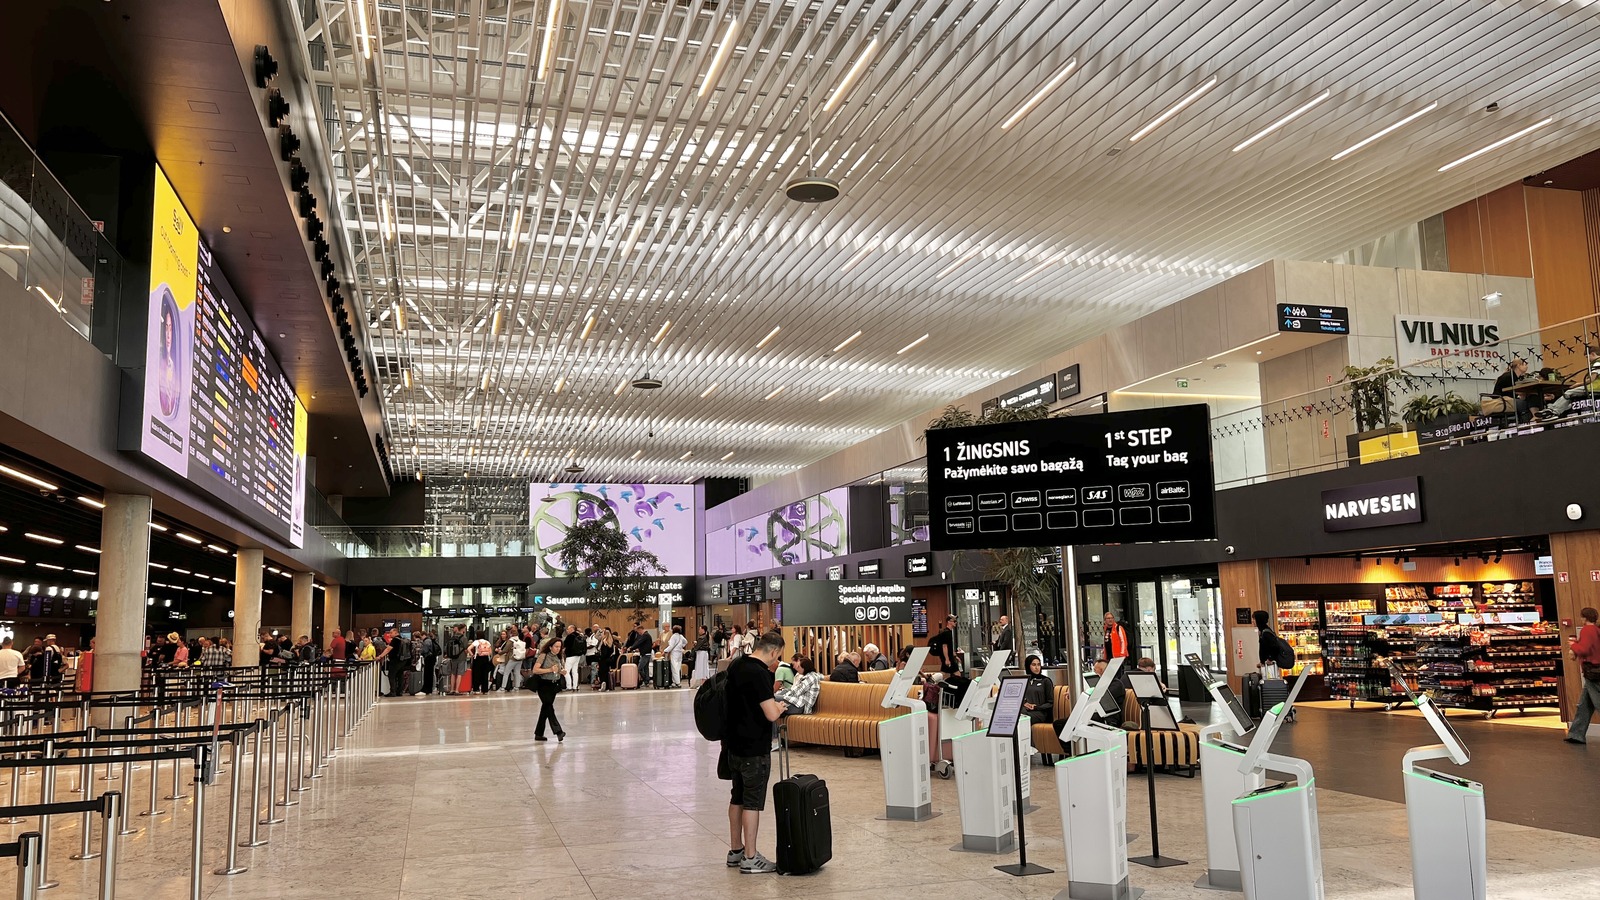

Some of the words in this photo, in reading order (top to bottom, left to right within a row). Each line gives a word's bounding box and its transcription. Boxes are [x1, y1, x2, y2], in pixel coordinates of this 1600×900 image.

[1401, 320, 1500, 347] VILNIUS
[1431, 348, 1450, 356] BAR
[1464, 350, 1499, 358] BISTRO
[1104, 430, 1125, 448] 1st
[1127, 427, 1173, 447] STEP
[944, 446, 951, 462] 1
[957, 440, 1030, 461] ŽINGSNIS
[1105, 454, 1129, 468] Tag
[1131, 453, 1161, 468] your
[1163, 450, 1189, 464] bag
[944, 463, 1008, 480] Pažymėkite
[1010, 463, 1038, 474] savo
[1040, 457, 1084, 473] bagažą
[1086, 489, 1109, 500] SAS
[1160, 486, 1186, 495] airBaltic
[1325, 492, 1417, 520] NARVESEN
[660, 582, 682, 592] gates
[838, 584, 875, 594] Specialioji
[876, 584, 905, 594] pagalba
[546, 595, 585, 606] Saugumo
[839, 594, 866, 605] Special
[866, 594, 905, 603] Assistance
